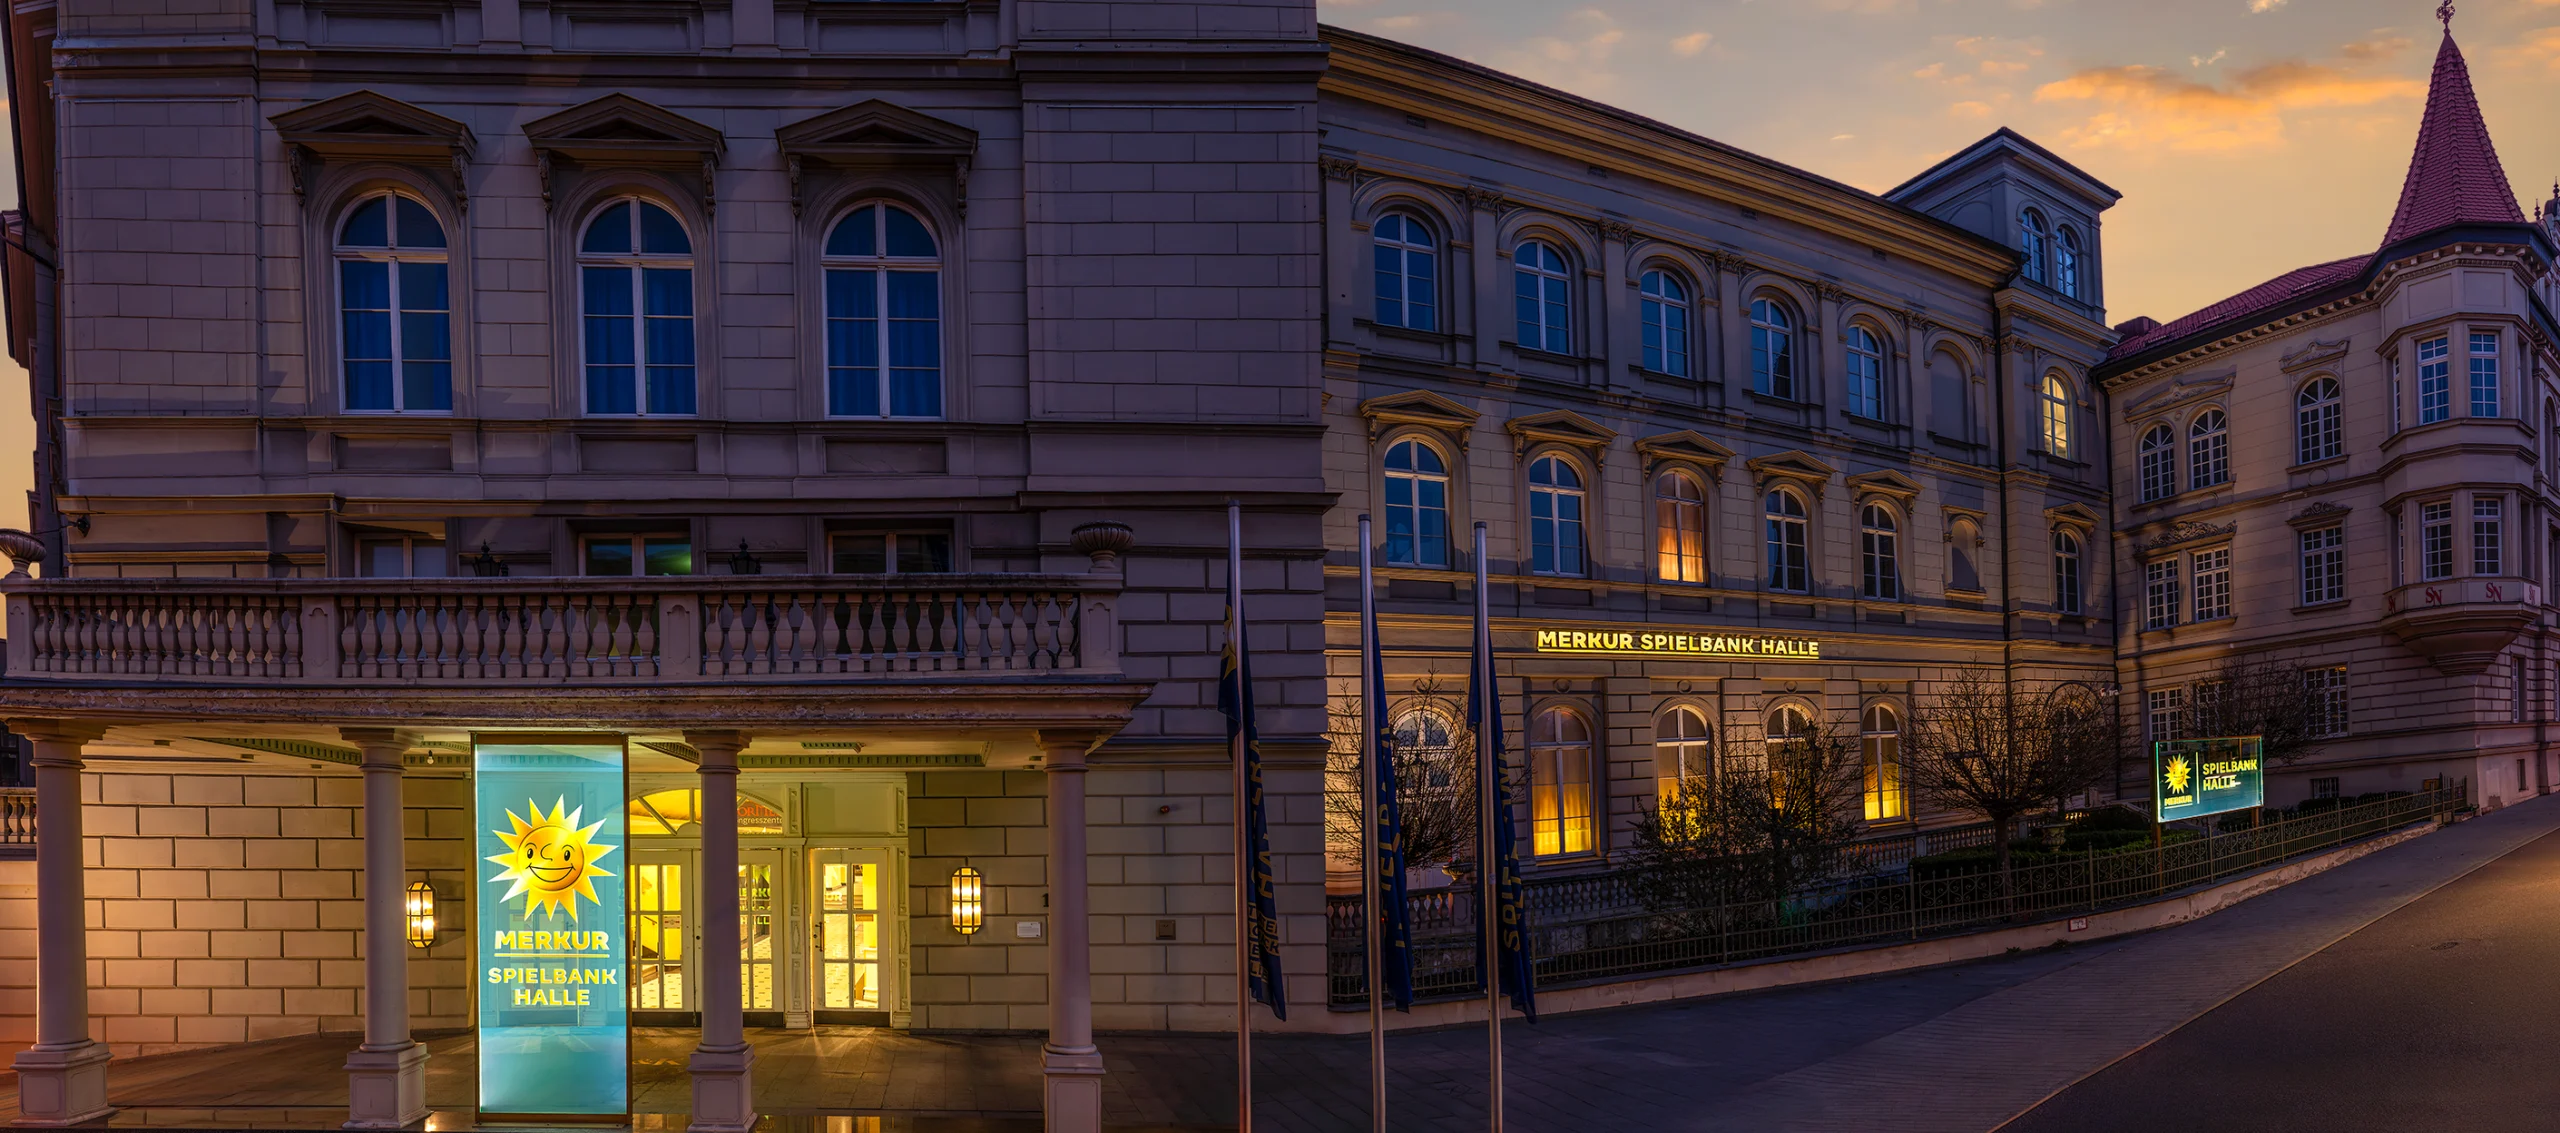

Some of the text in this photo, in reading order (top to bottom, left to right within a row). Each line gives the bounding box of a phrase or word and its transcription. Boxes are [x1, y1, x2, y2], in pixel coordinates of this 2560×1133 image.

[1538, 631, 1820, 655] MERKUR SPIELBANK HALLE
[2203, 760, 2258, 775] SPIELBANK
[2203, 775, 2238, 791] HALLE
[494, 931, 610, 950] MERKUR
[488, 967, 617, 984] SPIELBANK
[514, 989, 590, 1006] HALLE
